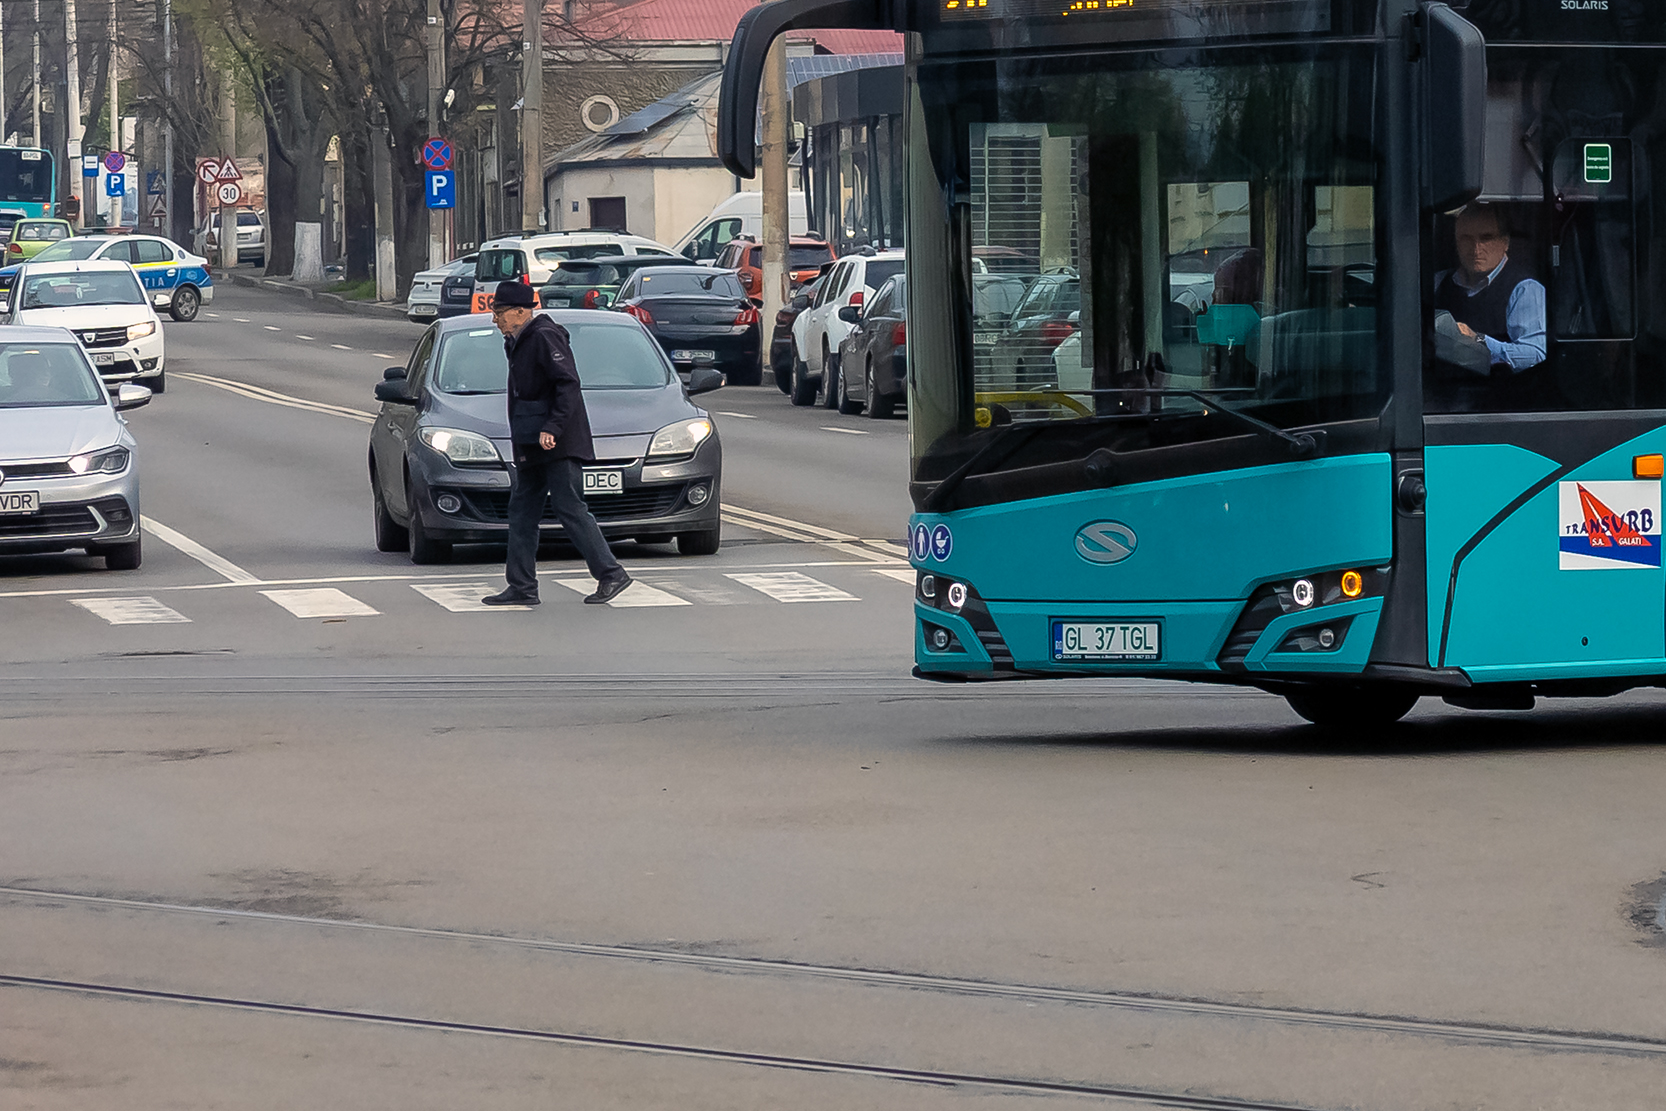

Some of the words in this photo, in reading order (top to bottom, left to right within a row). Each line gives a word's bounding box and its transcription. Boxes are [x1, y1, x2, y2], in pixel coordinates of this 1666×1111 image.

[1560, 0, 1609, 10] SOLARIS
[110, 175, 121, 189] P
[432, 174, 448, 196] P
[222, 187, 237, 200] 30
[585, 473, 619, 488] DEC
[0, 494, 33, 510] VDR
[1565, 508, 1654, 534] TRANSURB
[1592, 537, 1605, 546] S.A.
[1065, 626, 1088, 651] GL
[1095, 626, 1116, 651] 37
[1119, 626, 1154, 651] TGL
